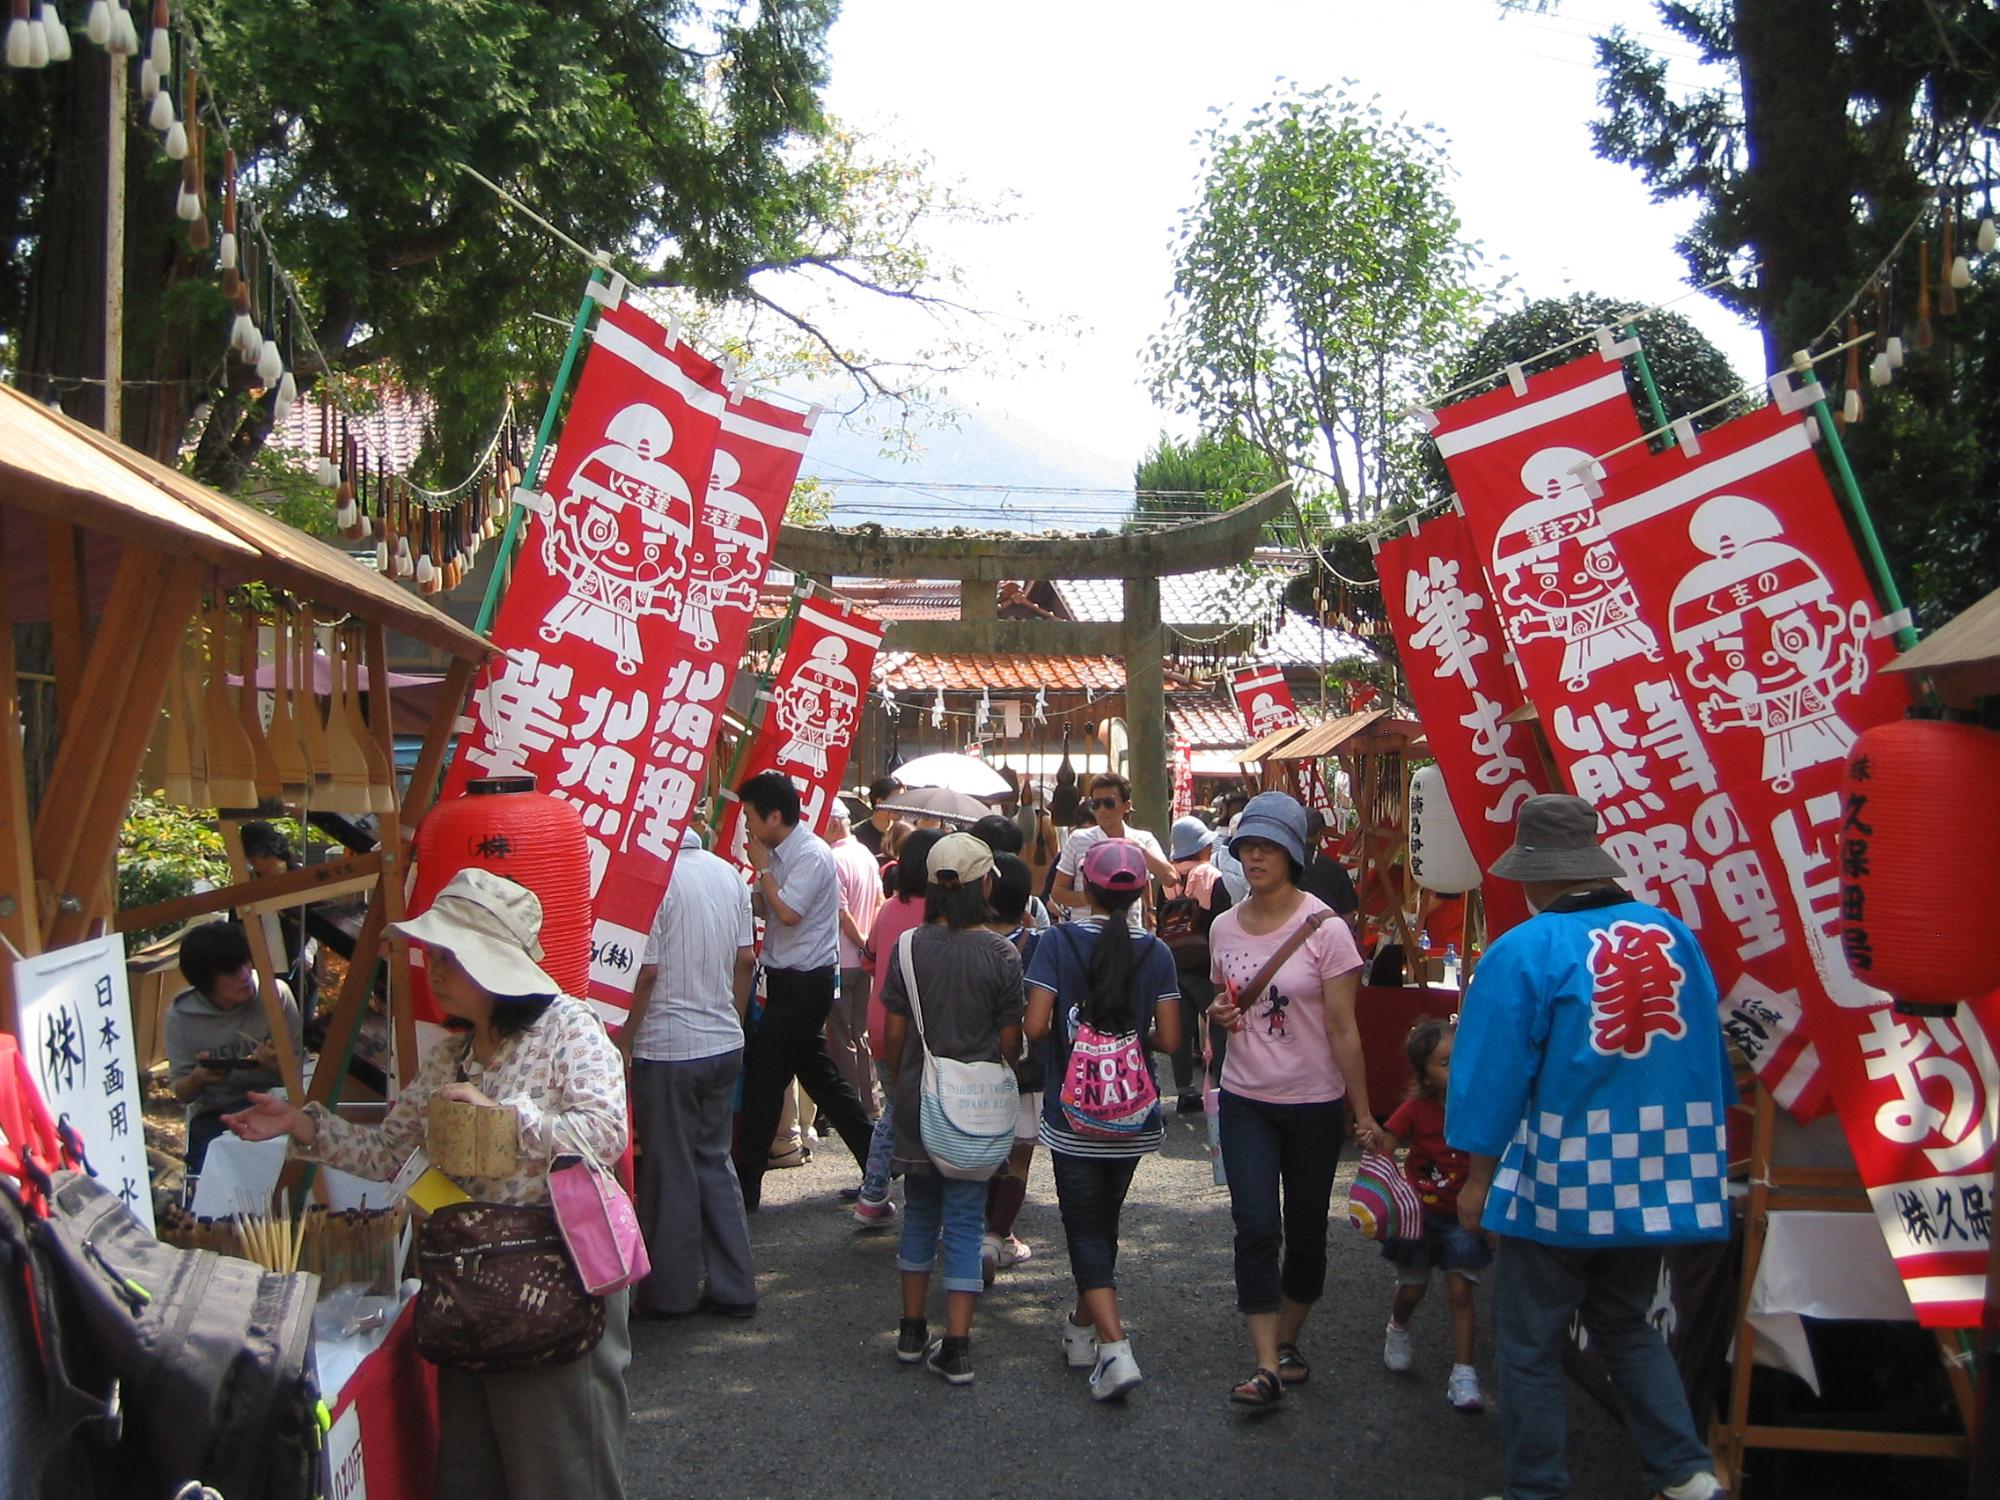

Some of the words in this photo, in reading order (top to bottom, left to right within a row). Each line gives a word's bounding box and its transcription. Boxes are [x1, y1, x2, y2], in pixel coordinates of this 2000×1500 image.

[1525, 508, 1596, 547] 筆まつり
[1705, 571, 1780, 615] くまの
[1553, 703, 1706, 929] 熊野
[1634, 675, 1786, 961] 筆の里
[1587, 920, 1686, 1058] 筆
[1084, 1071, 1145, 1107] NAILS
